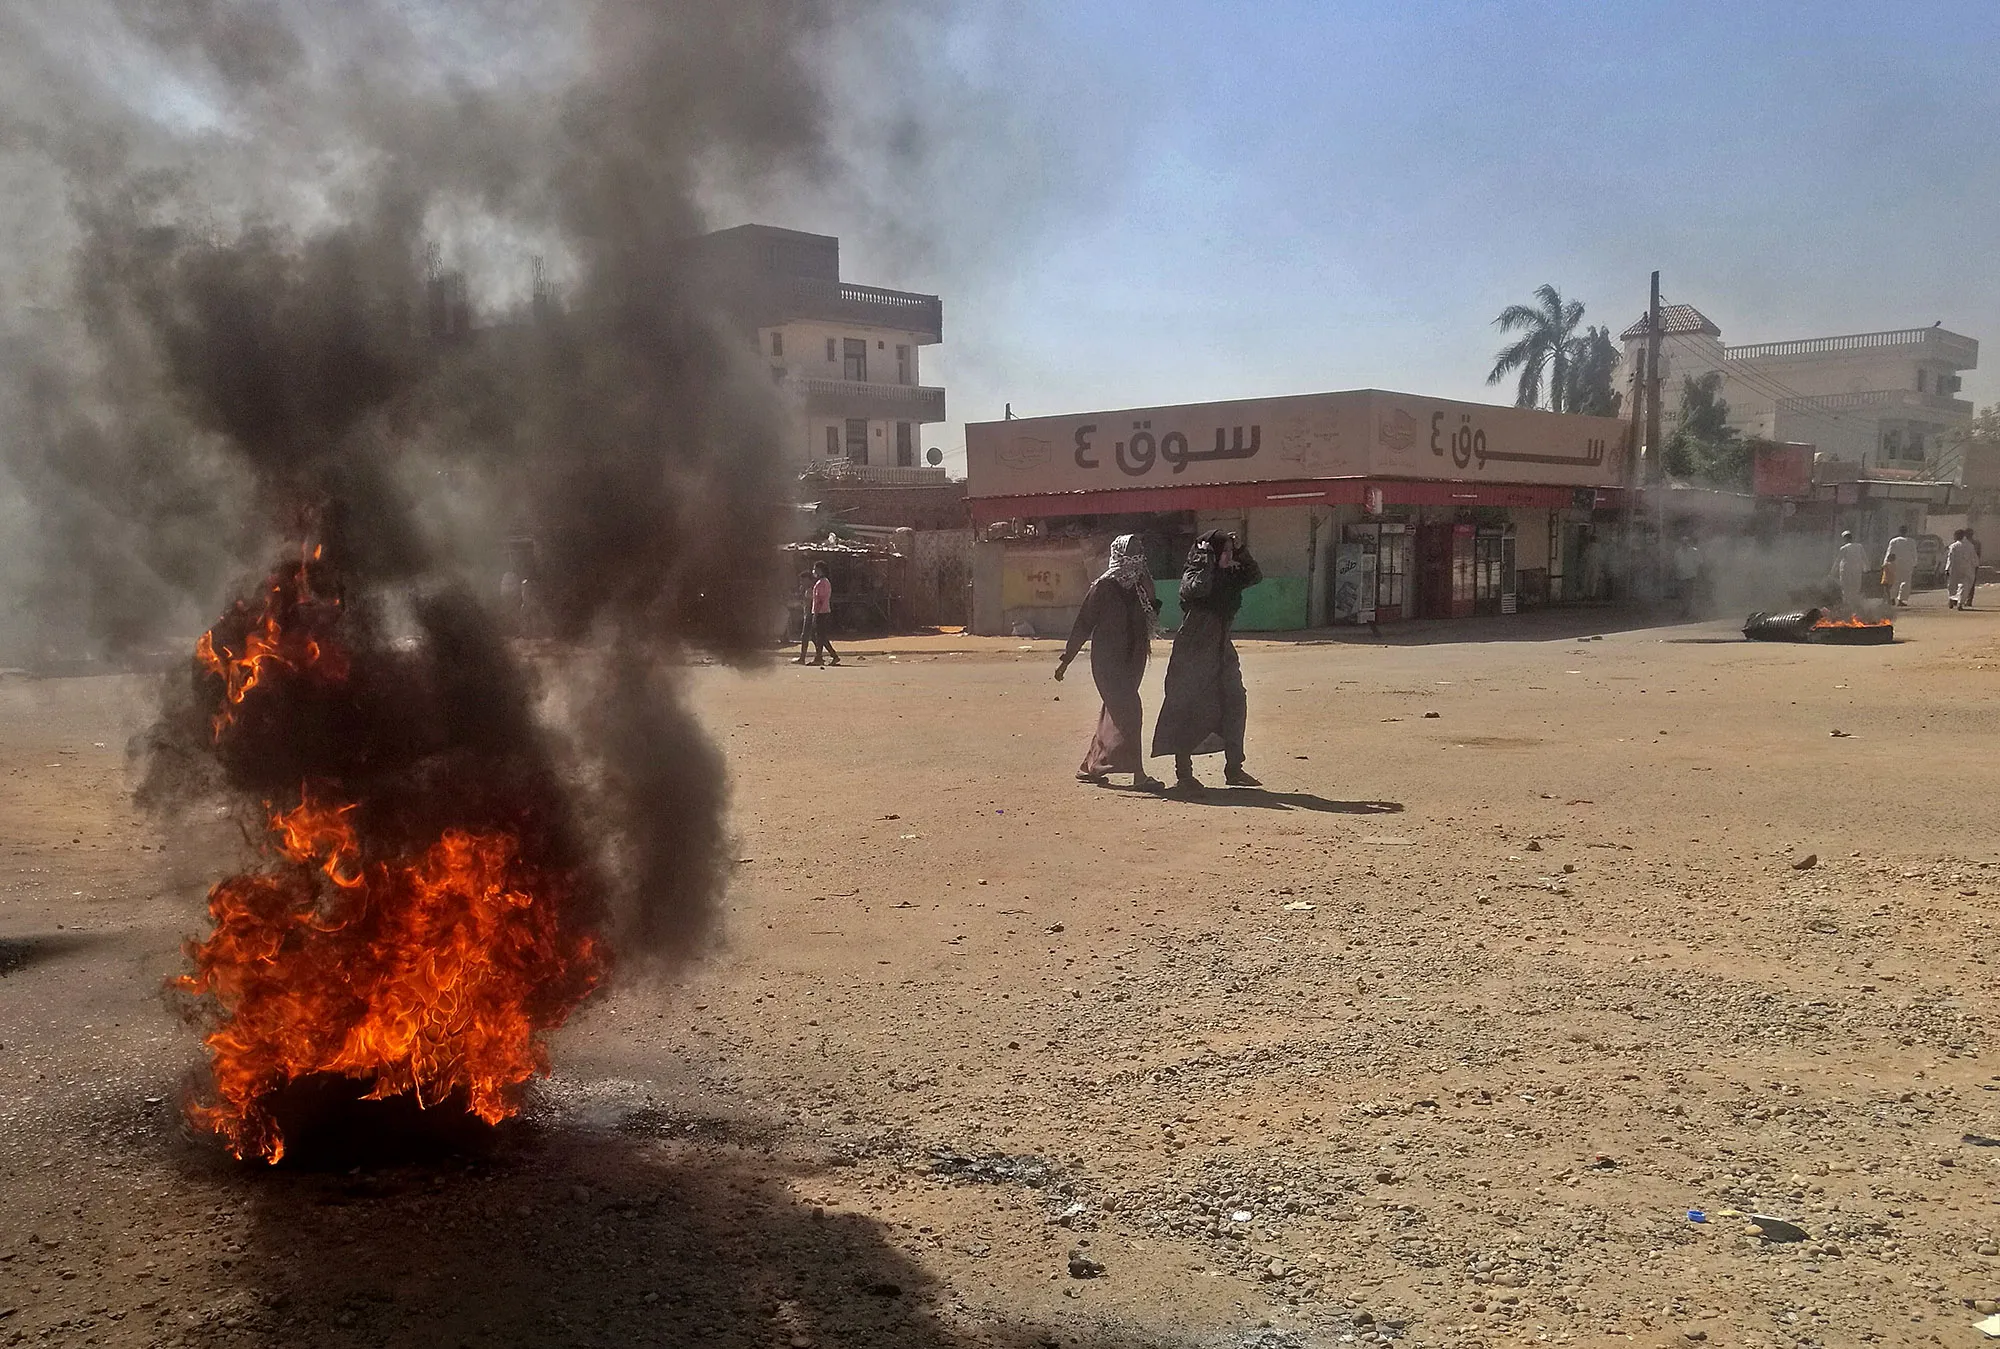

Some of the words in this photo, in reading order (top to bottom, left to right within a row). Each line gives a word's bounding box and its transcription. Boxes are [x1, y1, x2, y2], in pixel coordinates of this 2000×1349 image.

[1074, 424, 1100, 469] ٤
[1115, 420, 1261, 477] سوق
[1430, 410, 1444, 457] ٤
[1451, 413, 1605, 471] سوق
